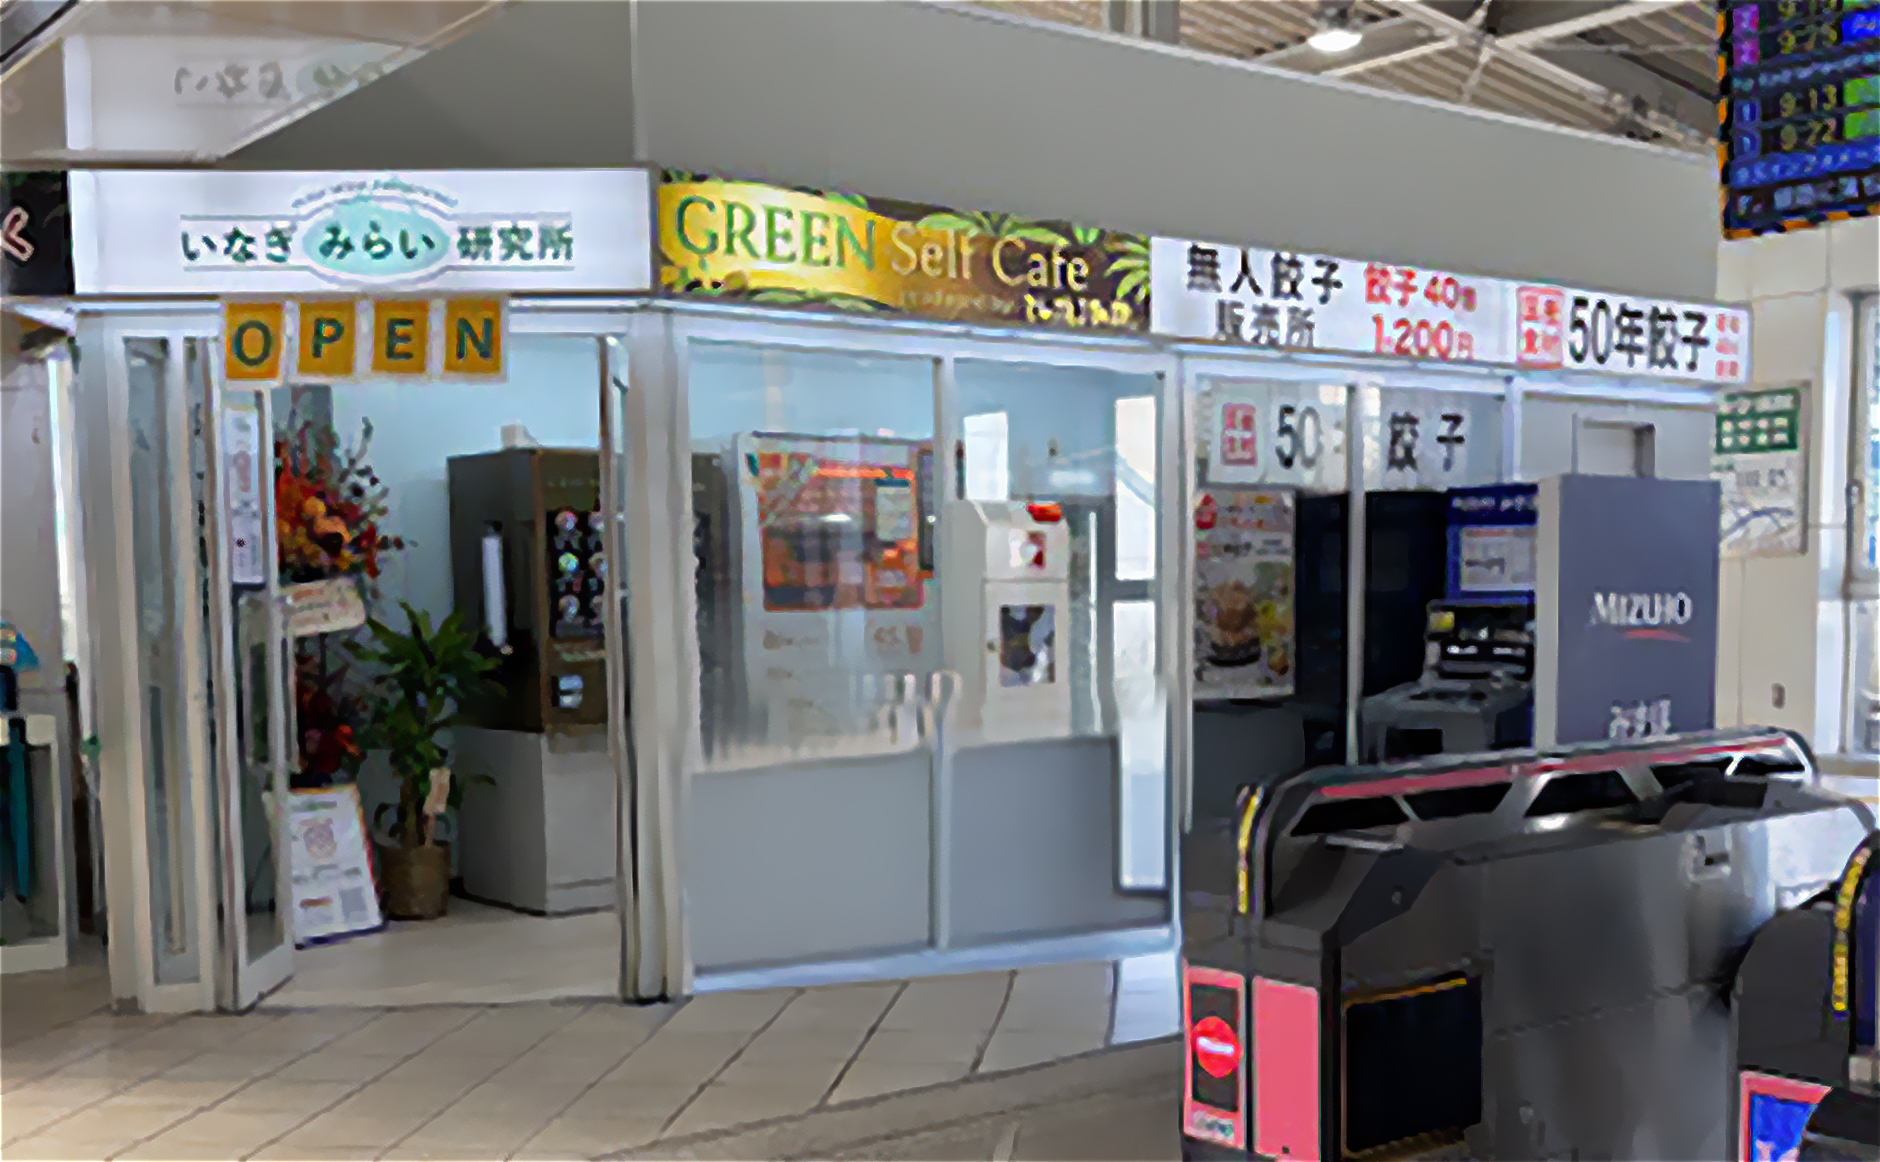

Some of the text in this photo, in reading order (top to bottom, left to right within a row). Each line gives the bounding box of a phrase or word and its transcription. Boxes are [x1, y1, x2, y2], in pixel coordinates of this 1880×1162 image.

[318, 219, 436, 261] みらい
[676, 194, 1090, 292] GREEN Self Cafe
[233, 316, 494, 368] OPEN
[1569, 296, 1711, 372] 50年餃子
